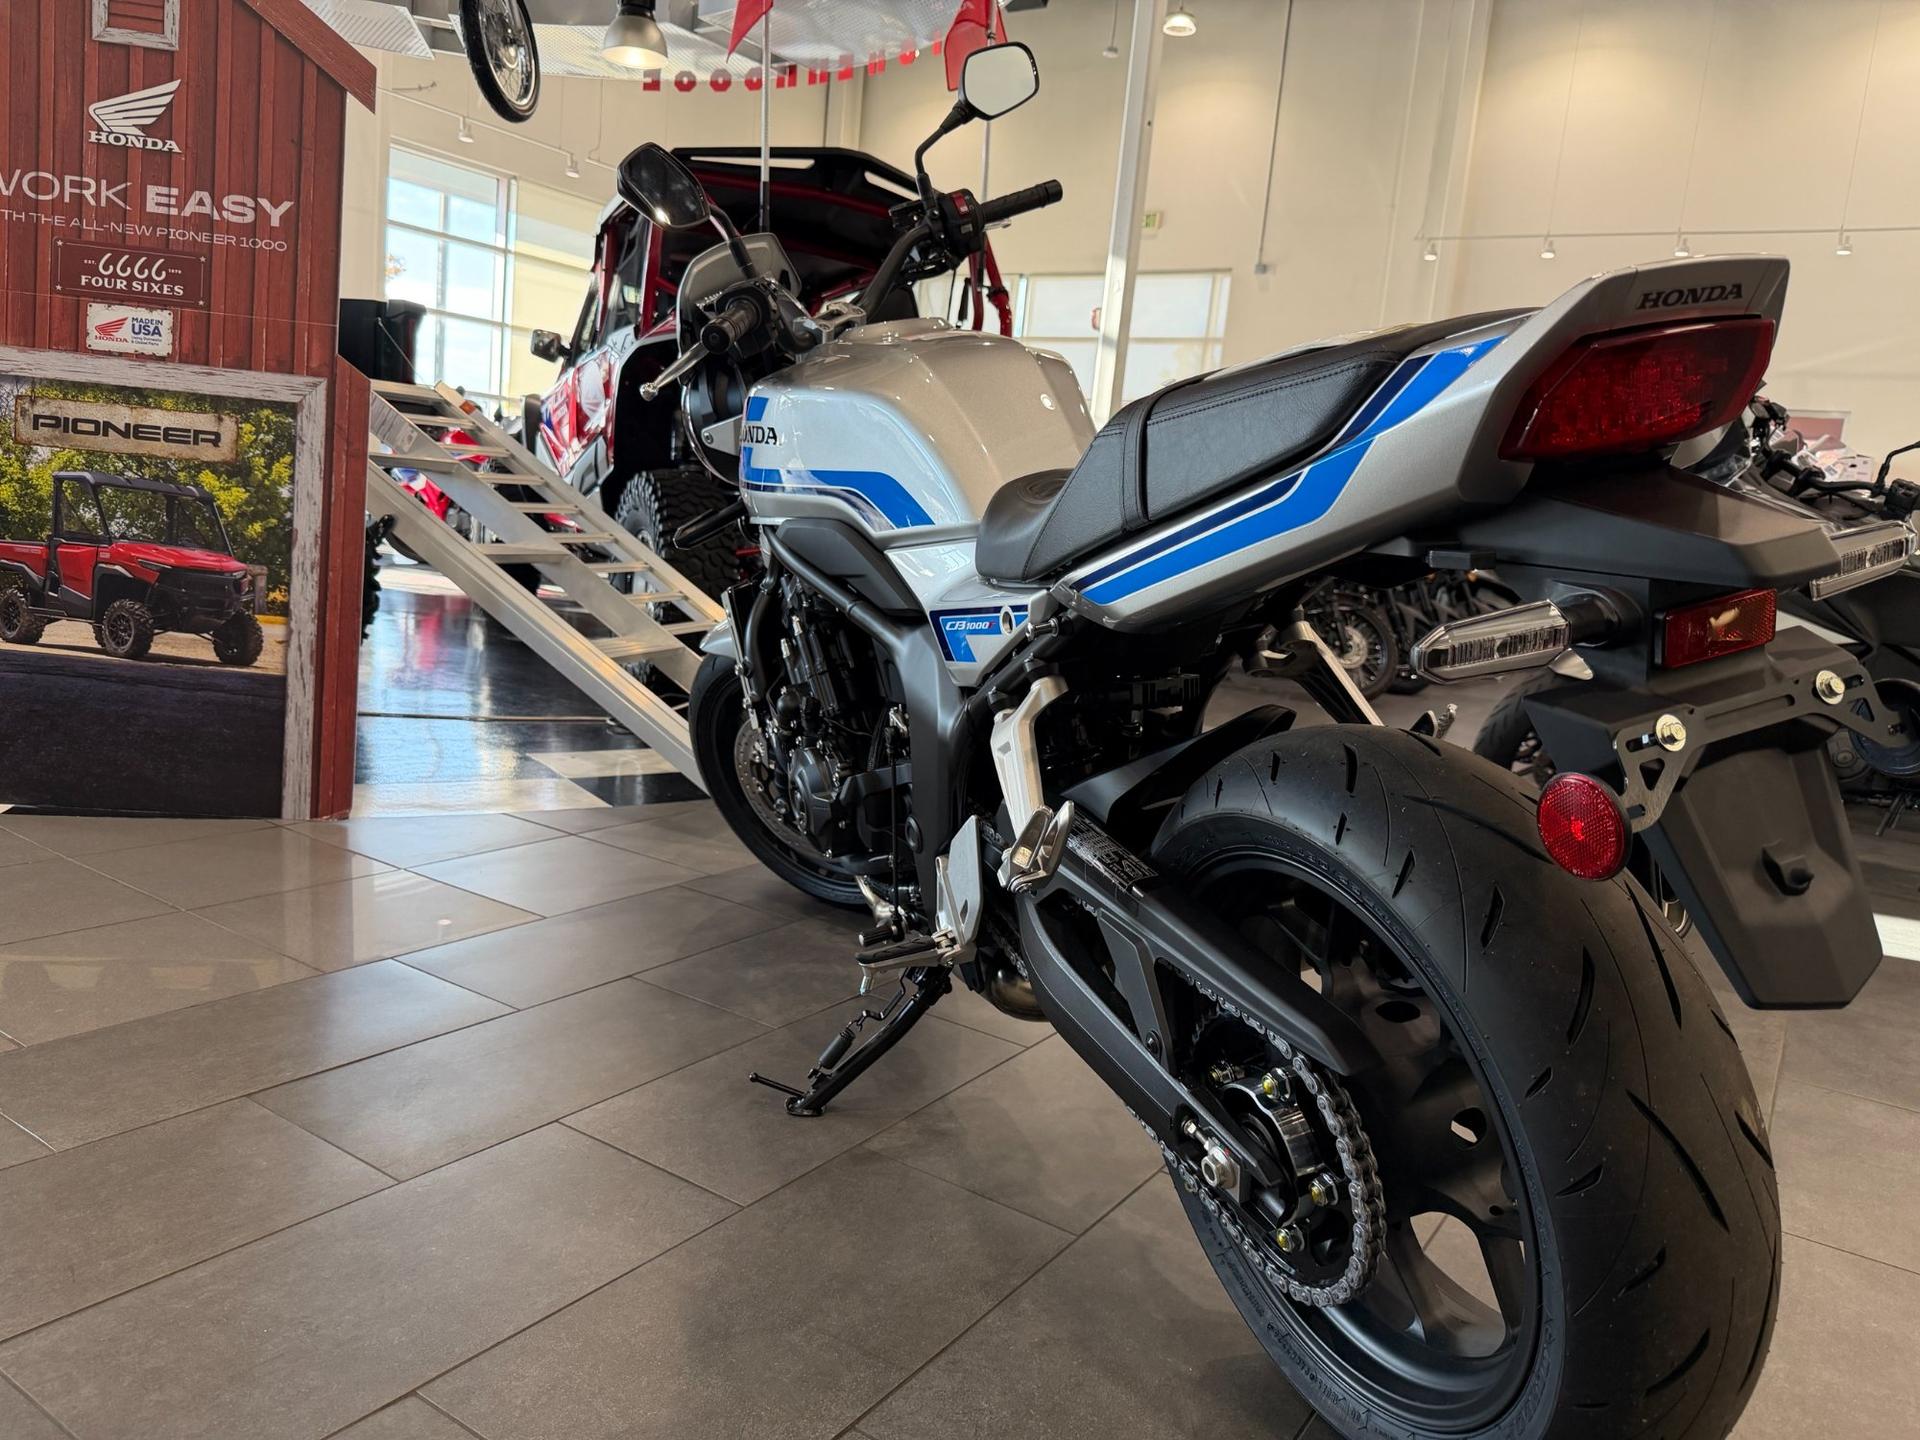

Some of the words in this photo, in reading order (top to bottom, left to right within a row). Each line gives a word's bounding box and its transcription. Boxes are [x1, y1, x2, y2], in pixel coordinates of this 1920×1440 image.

[89, 130, 182, 153] HONDA
[146, 185, 294, 228] EASY
[29, 212, 66, 227] THE
[69, 217, 152, 237] ALL-NEW
[156, 226, 236, 247] PIONEER
[240, 236, 287, 252] 1000
[98, 252, 166, 281] 6666
[80, 275, 128, 290] FOUR
[131, 280, 184, 296] SIXES
[1635, 283, 1743, 310] HONDA
[131, 317, 154, 325] MADE
[131, 323, 162, 337] USA
[94, 335, 129, 343] HONDA
[32, 413, 222, 448] PIONEER
[742, 425, 777, 445] ONDA
